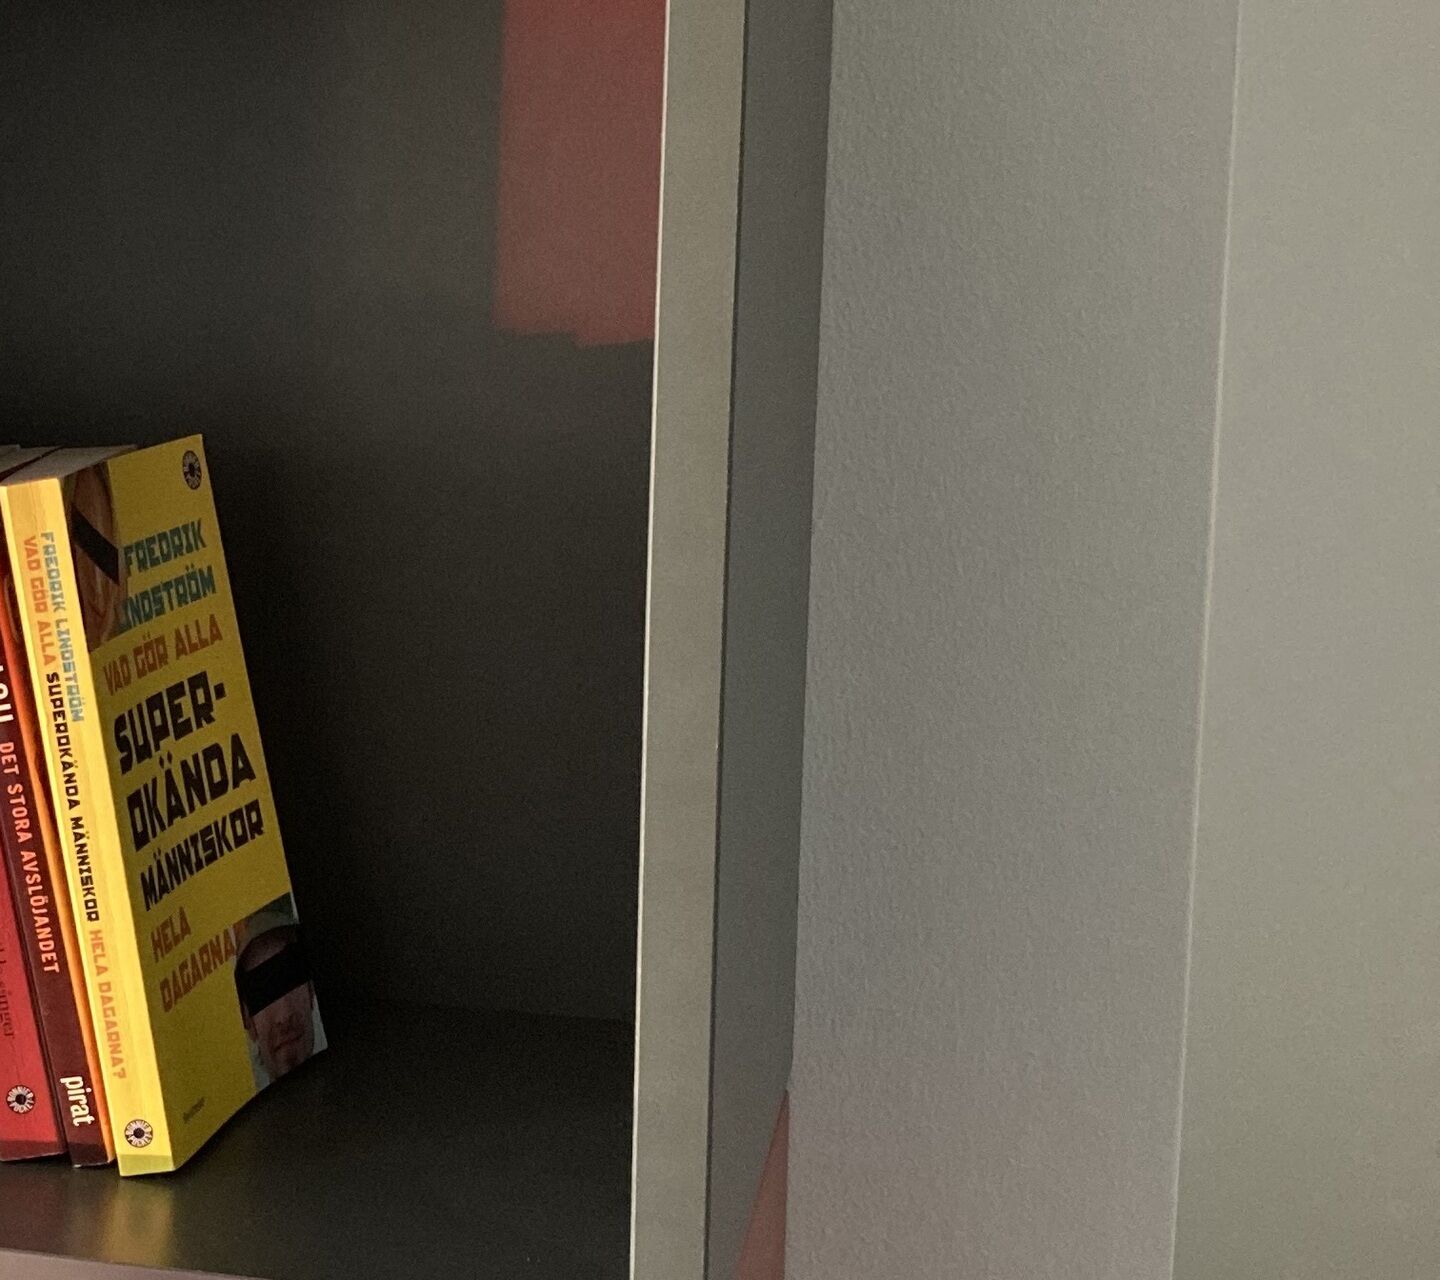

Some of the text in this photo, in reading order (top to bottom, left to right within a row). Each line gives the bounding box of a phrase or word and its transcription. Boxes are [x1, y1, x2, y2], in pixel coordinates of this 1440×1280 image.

[23, 535, 41, 571] VAD
[122, 518, 207, 577] FREDRIK
[37, 620, 57, 667] ALLA
[41, 531, 85, 722] FREDRIK LINDSTRÖM
[103, 614, 223, 696] VAD GÖR ALLA
[46, 672, 82, 810] SUPEROKÄNDA
[114, 671, 226, 776] SUPER-
[127, 732, 257, 852] OKÄNDA
[7, 783, 33, 843] STORA
[20, 850, 60, 973] AVSLÖJANDET
[70, 816, 100, 922] MÄNNISKOR
[140, 798, 265, 912] MÄNNISKOR
[89, 929, 104, 977] HELA
[151, 906, 191, 963] HELA
[60, 1075, 96, 1127] pirat
